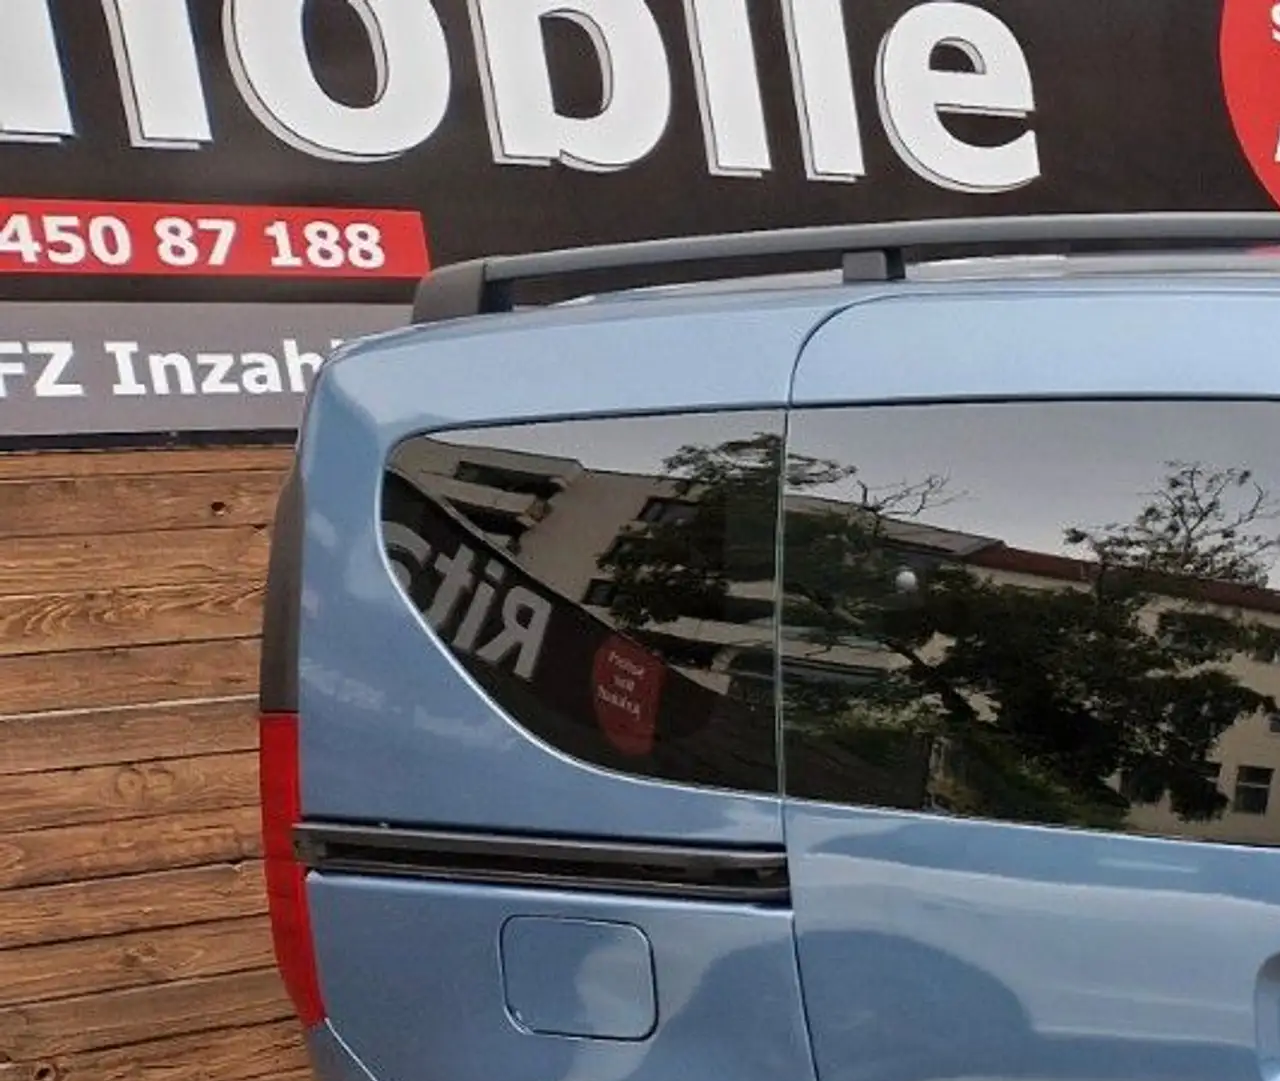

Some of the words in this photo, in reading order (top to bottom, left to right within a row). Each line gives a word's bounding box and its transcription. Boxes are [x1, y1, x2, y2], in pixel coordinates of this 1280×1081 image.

[0, 213, 131, 266] 450
[153, 216, 236, 267] 87
[264, 220, 385, 269] 188
